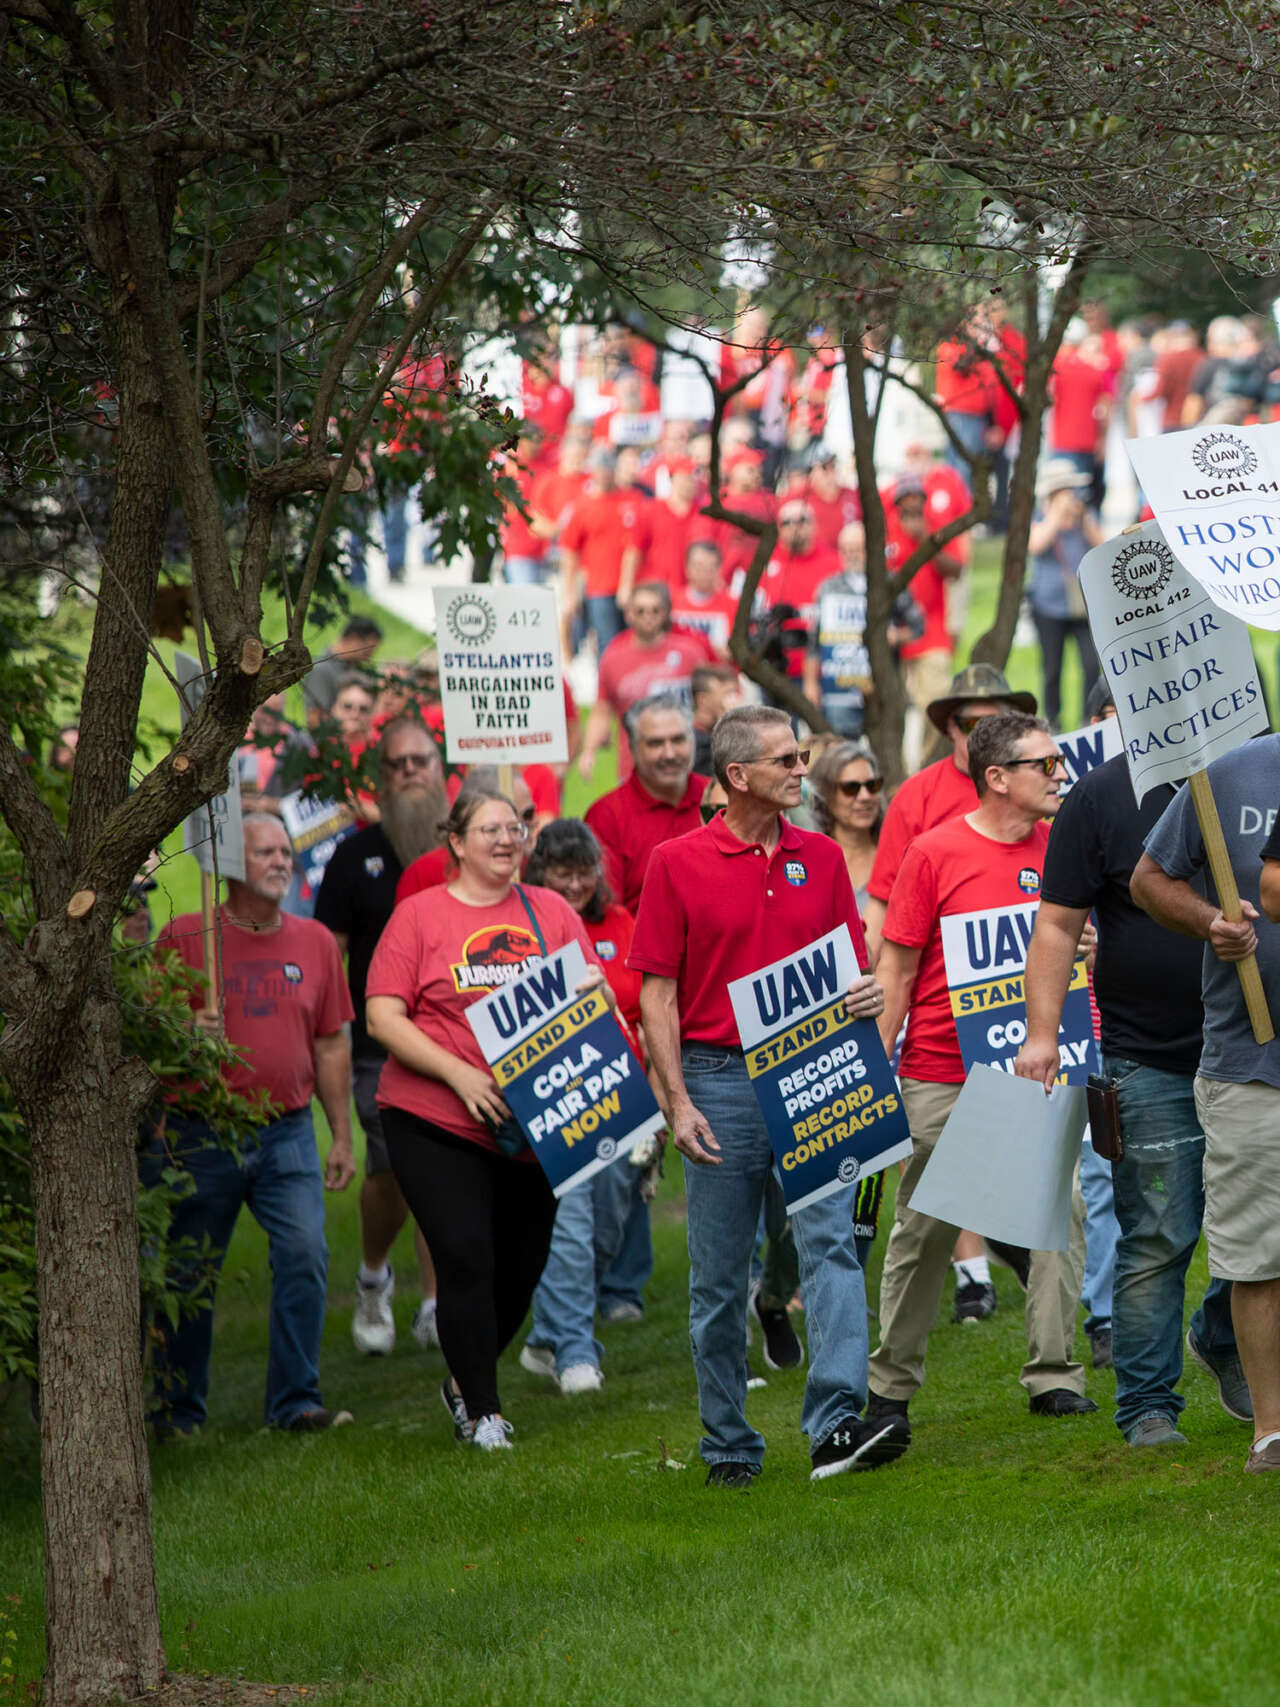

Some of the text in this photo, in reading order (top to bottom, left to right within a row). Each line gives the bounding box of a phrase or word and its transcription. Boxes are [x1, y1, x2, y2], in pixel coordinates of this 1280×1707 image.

[1209, 451, 1239, 464] UAW
[1183, 482, 1252, 500] LOCAL
[1128, 559, 1158, 580] UAW
[508, 610, 541, 627] 412
[1114, 587, 1192, 626] LOCAL 412
[444, 653, 553, 669] STELLANTIS
[1110, 613, 1222, 676] UNFAIR
[446, 676, 555, 692] BARGAINING
[472, 695, 531, 710] IN BAD
[1128, 658, 1224, 714] LABOR
[476, 713, 529, 728] FAITH
[459, 964, 523, 988] JURASSIC
[487, 958, 568, 1040] UAW
[752, 940, 838, 1027] UAW
[960, 981, 1023, 1011] STAN
[501, 1000, 597, 1079] STAND UP
[755, 1003, 848, 1071] STAND U
[532, 1042, 603, 1100] COLA
[565, 1076, 584, 1092] AND
[778, 1039, 859, 1098] RECORD
[784, 1058, 867, 1119] PROFITS
[526, 1051, 632, 1143] FAIR PAY
[560, 1089, 622, 1148] NOW
[792, 1083, 874, 1142] RECORD
[782, 1093, 899, 1172] CONTRACTS
